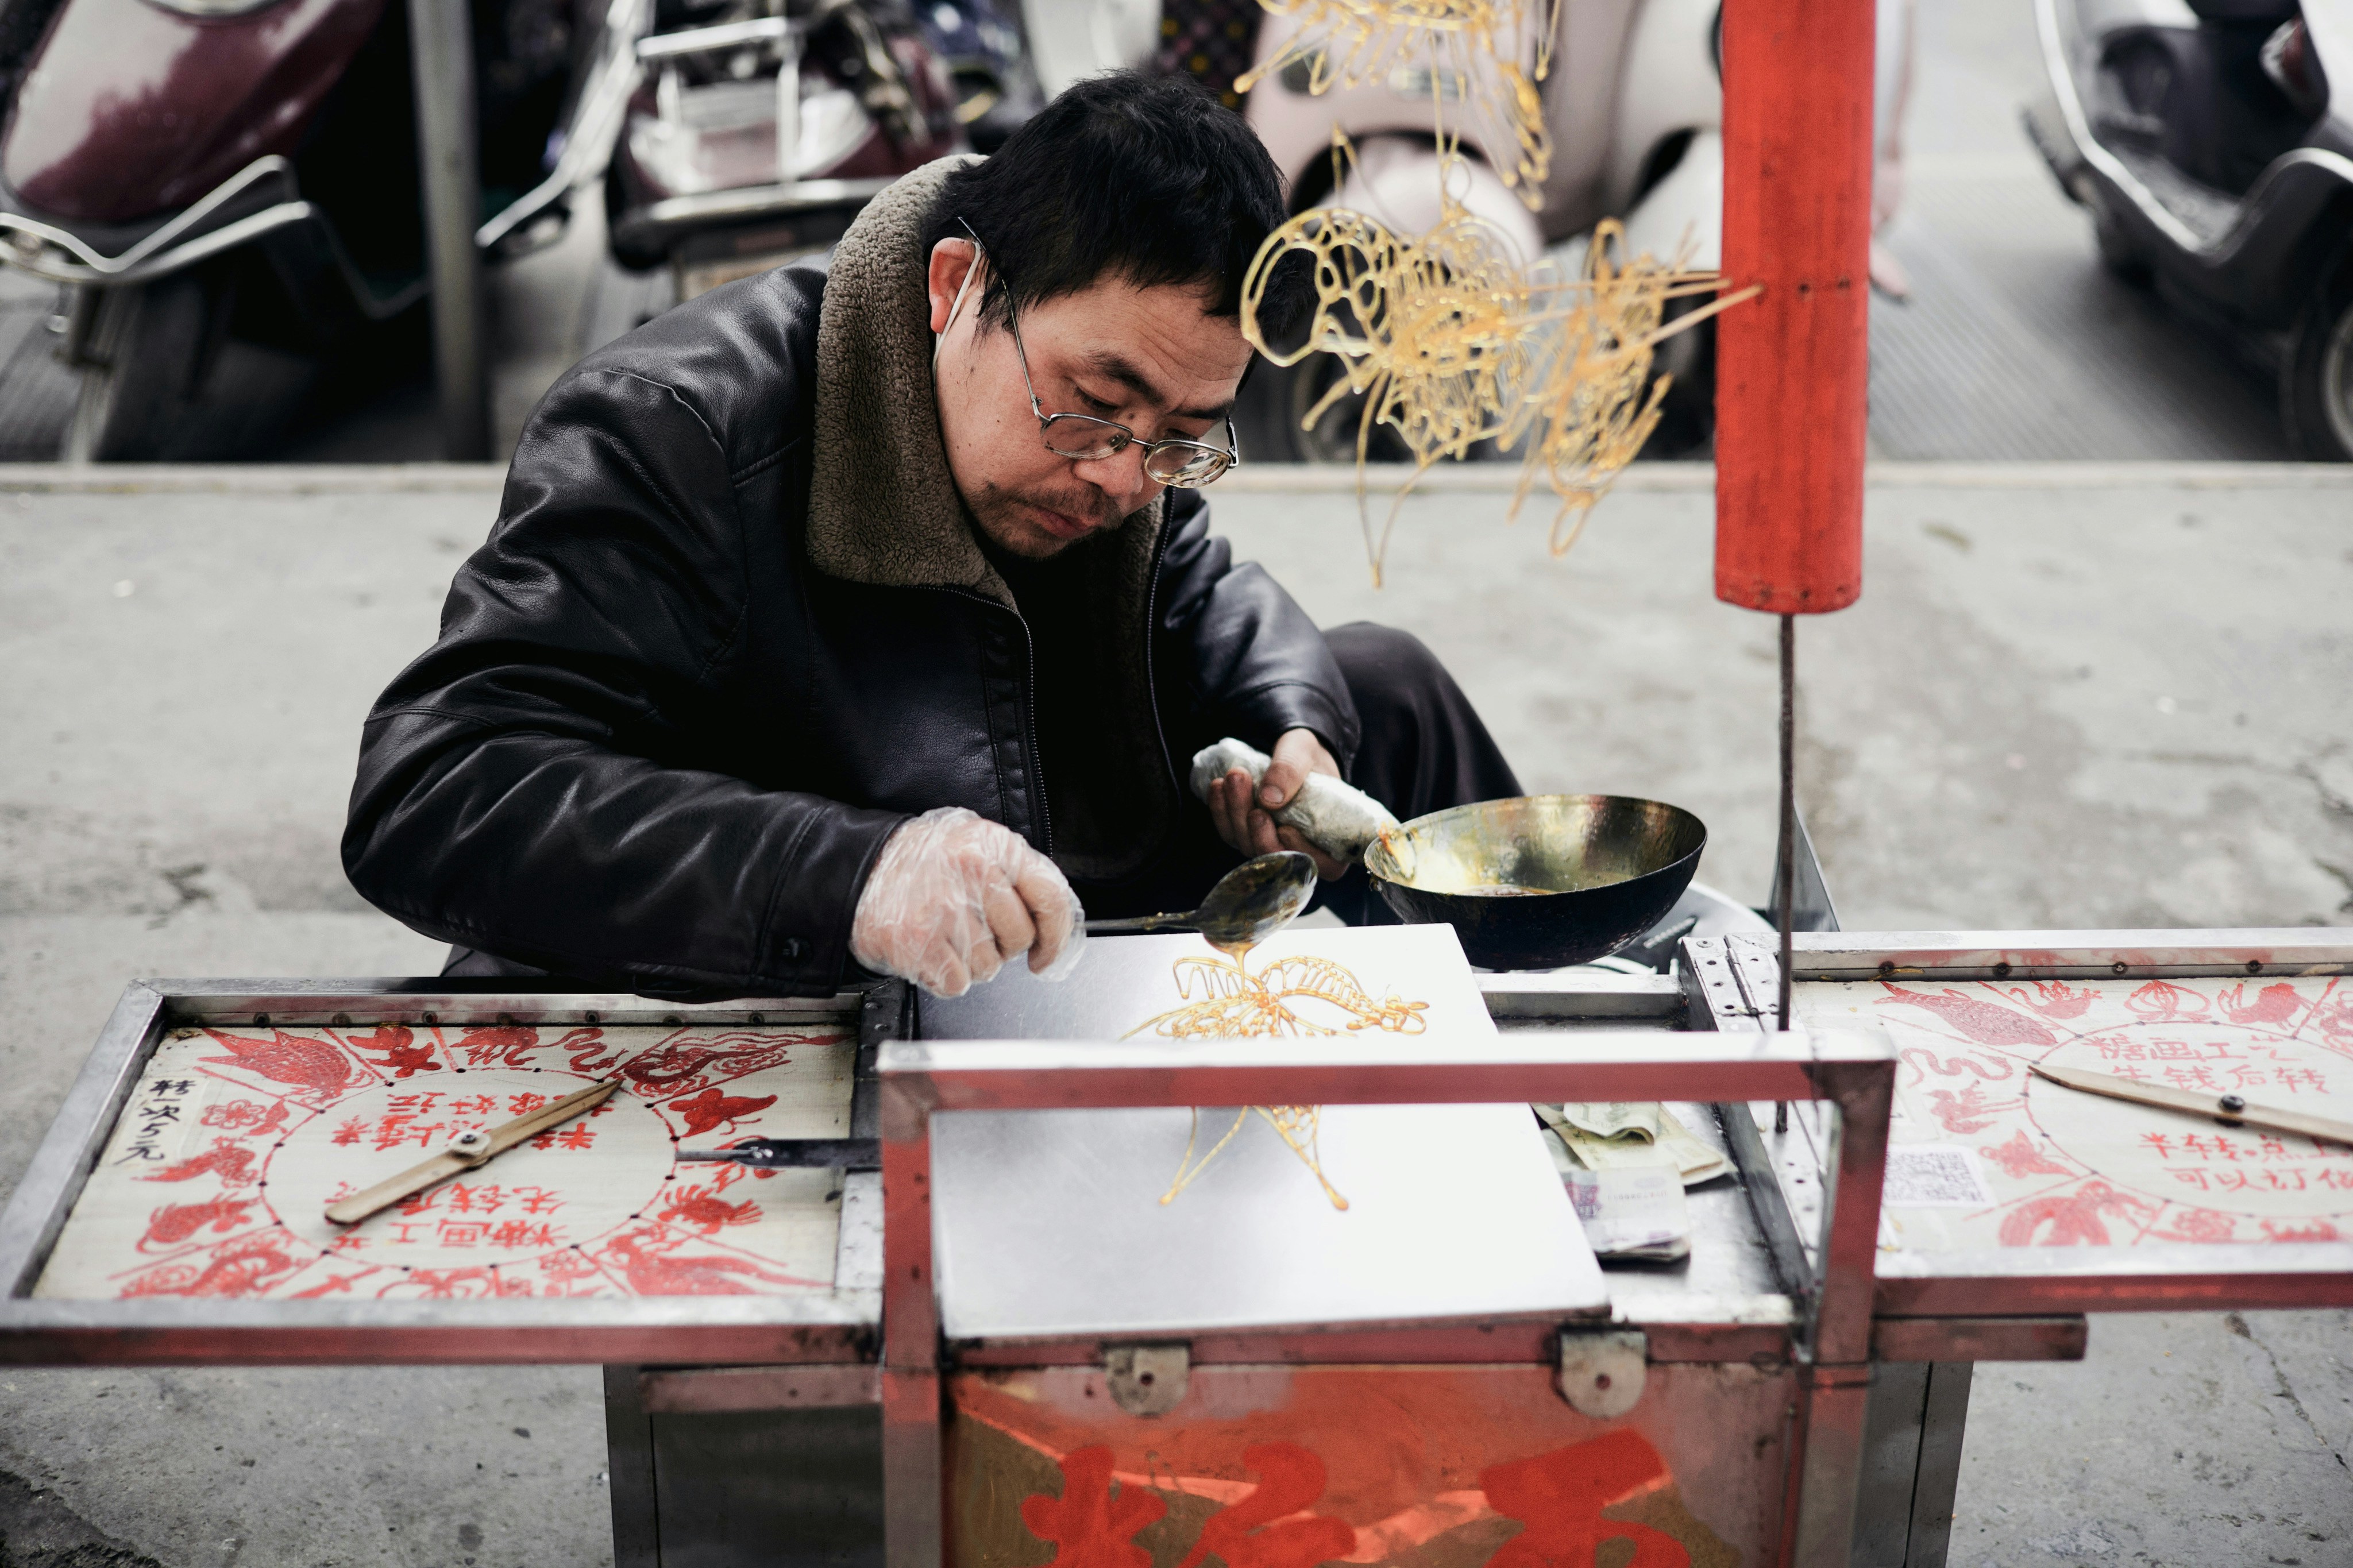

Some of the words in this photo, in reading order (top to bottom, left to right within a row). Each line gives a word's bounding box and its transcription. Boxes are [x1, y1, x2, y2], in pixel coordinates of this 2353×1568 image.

[2082, 1033, 2302, 1062] 糖画工艺
[387, 1091, 615, 1117] 你好运
[113, 1080, 196, 1165] 转一次5元
